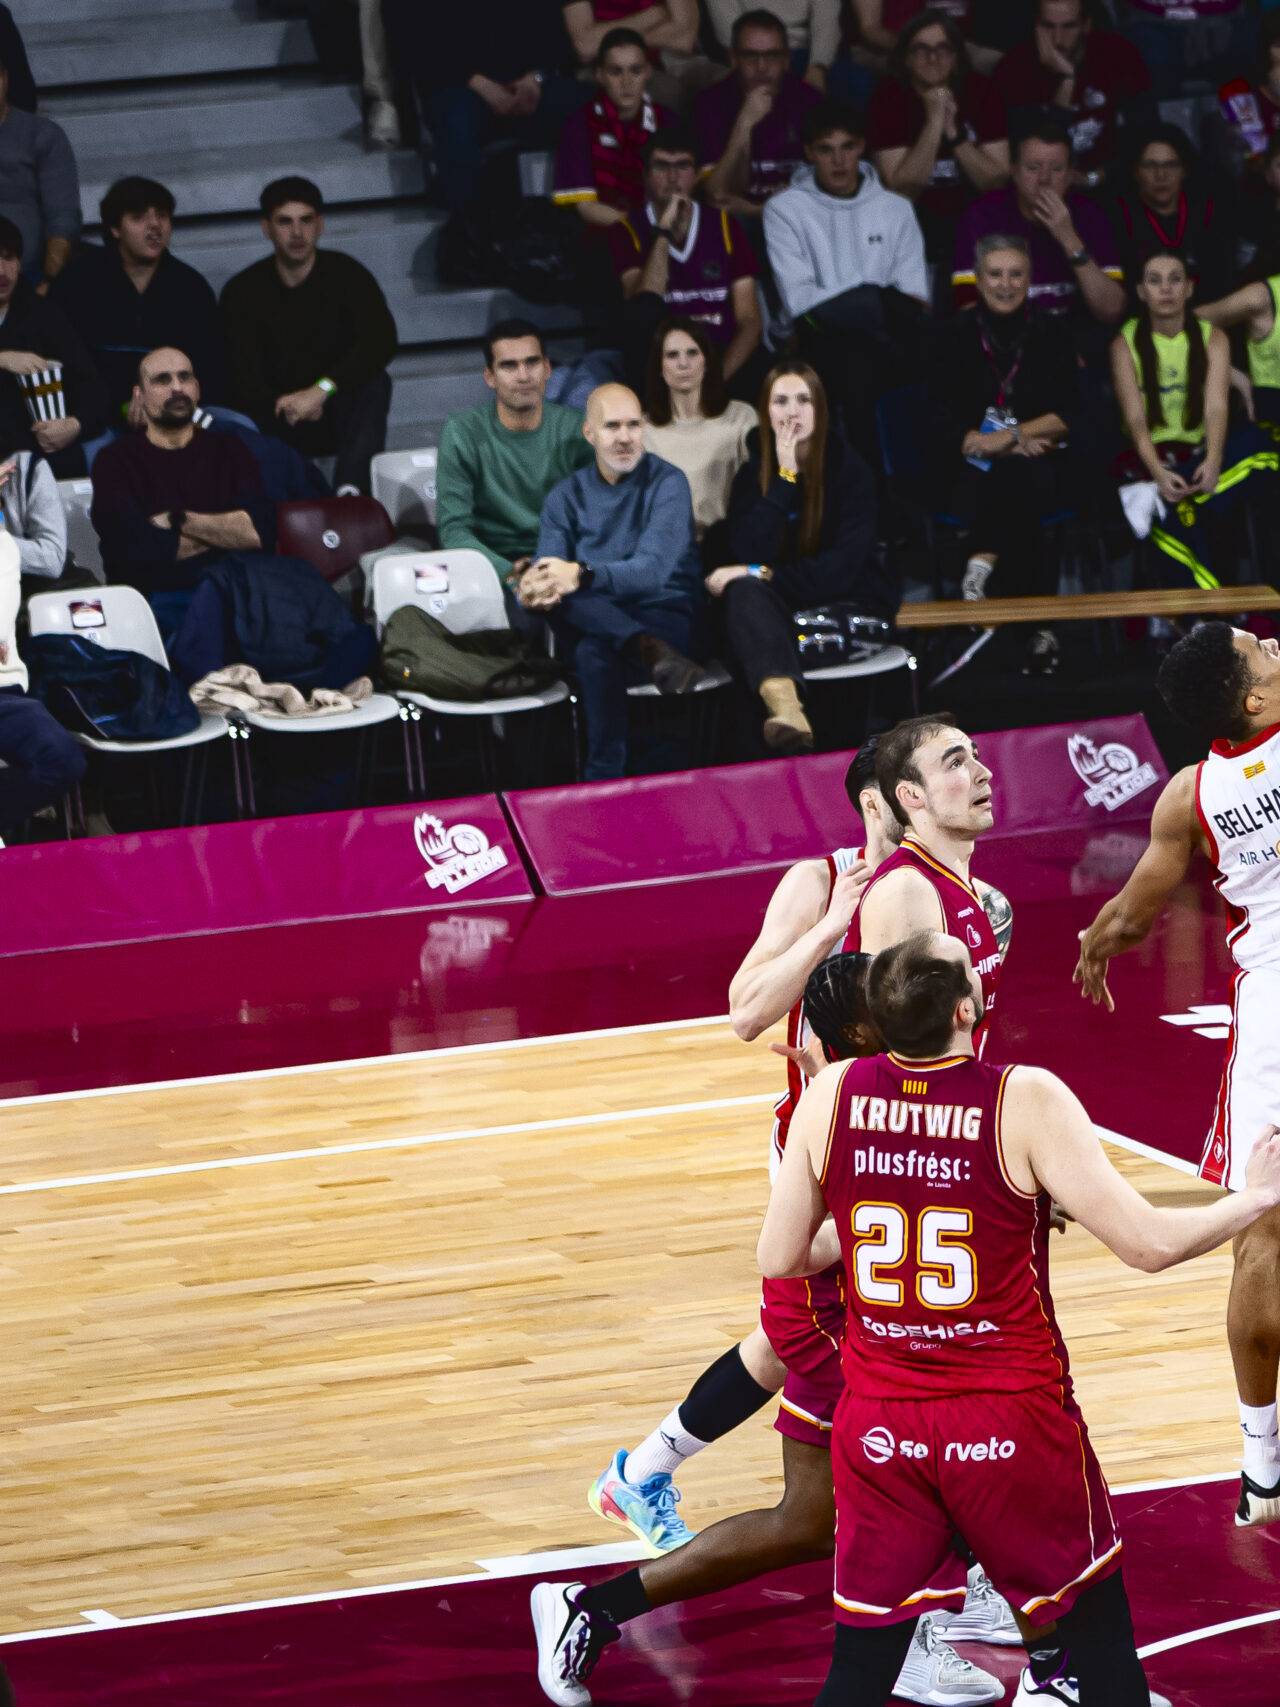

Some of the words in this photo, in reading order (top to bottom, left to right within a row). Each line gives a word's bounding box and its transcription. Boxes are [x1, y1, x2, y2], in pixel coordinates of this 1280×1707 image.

[1239, 851, 1260, 867] AIR
[848, 1094, 983, 1142] KRUTWIG
[850, 1200, 979, 1311] 25
